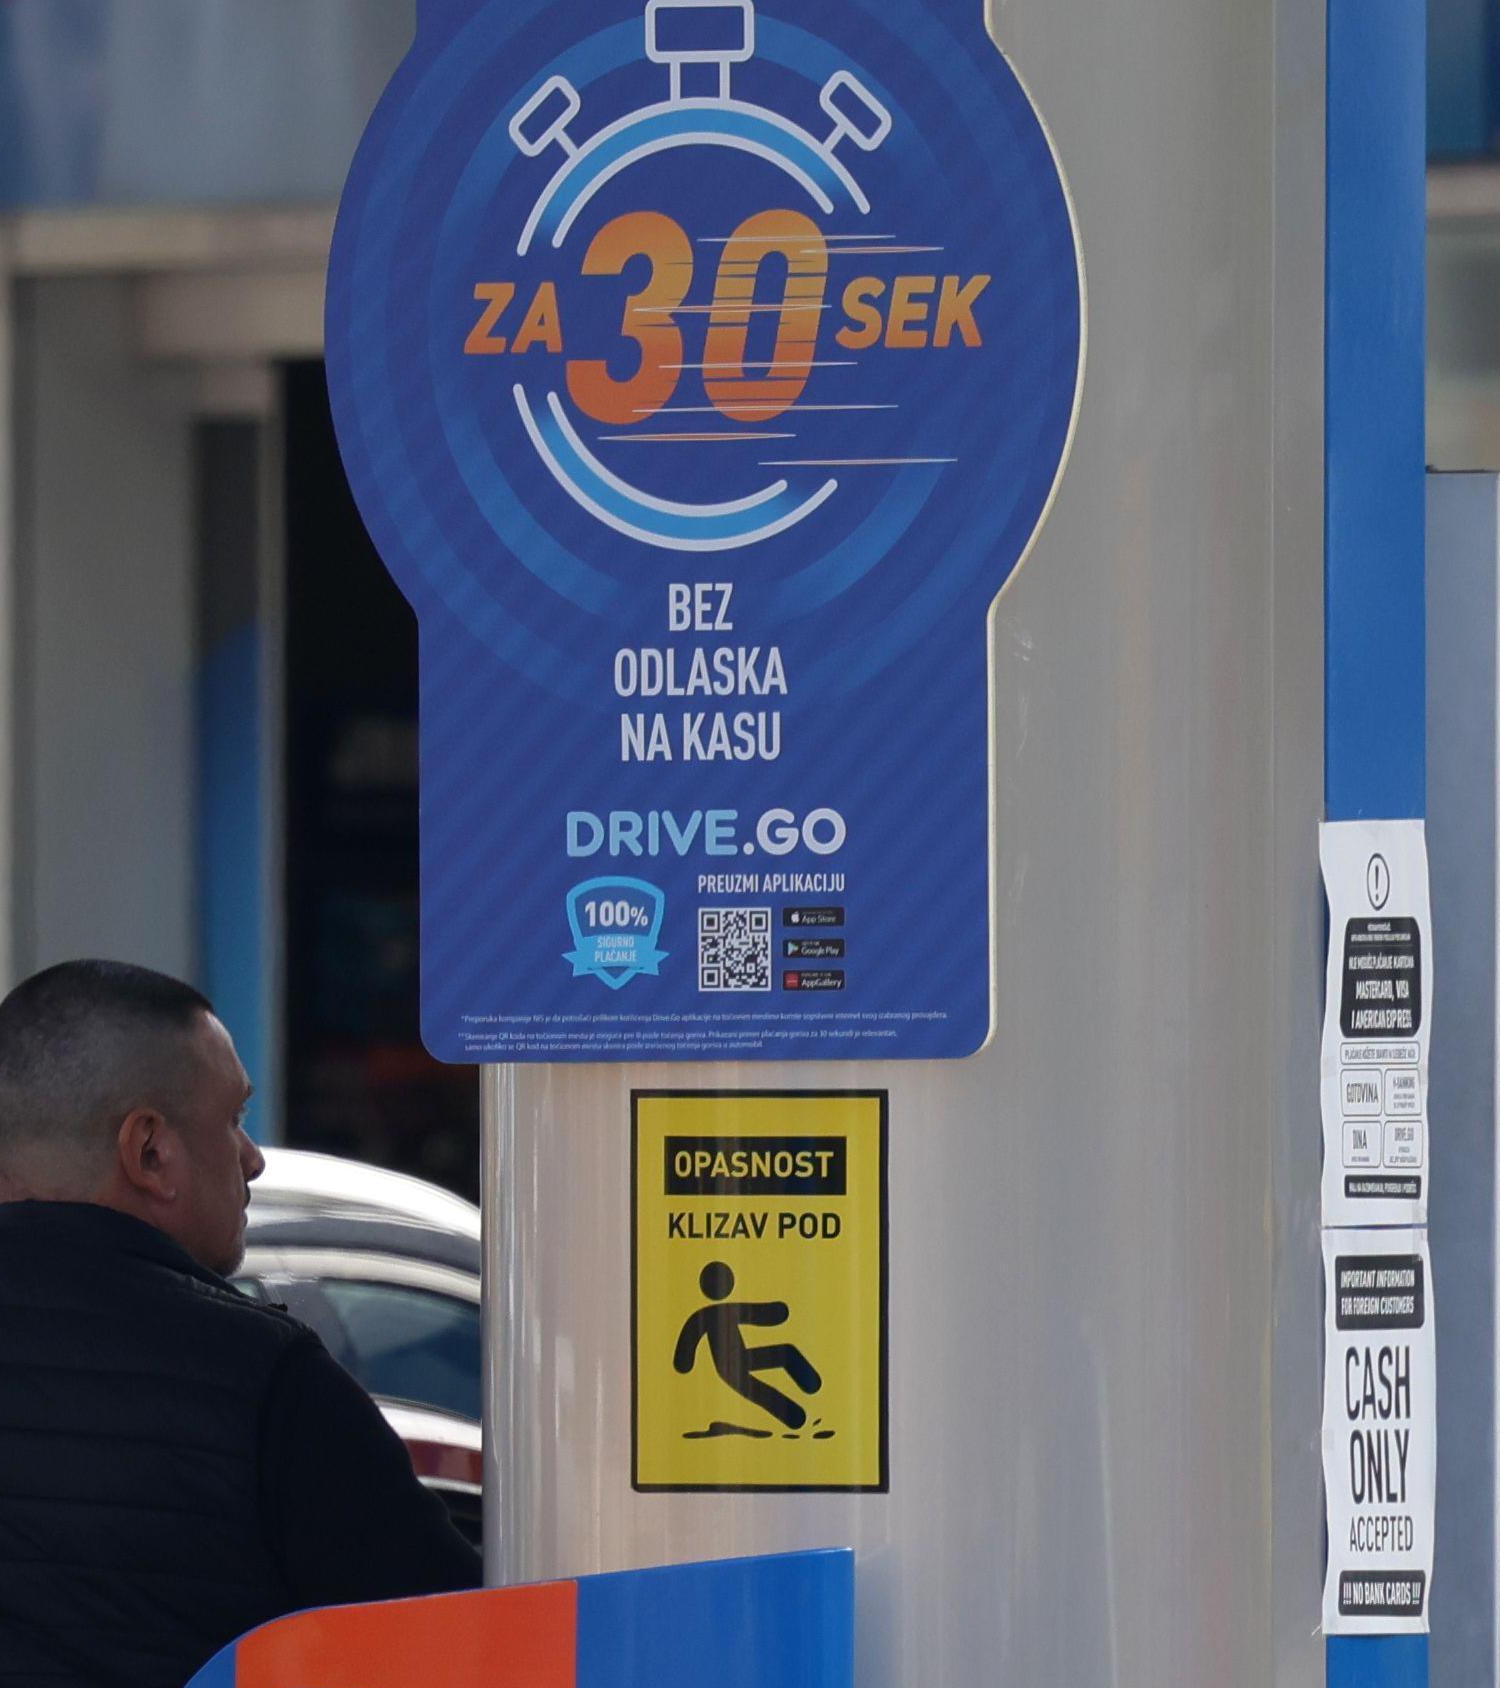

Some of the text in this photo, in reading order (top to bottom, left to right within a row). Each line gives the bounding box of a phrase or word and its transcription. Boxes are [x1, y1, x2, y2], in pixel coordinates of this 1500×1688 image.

[463, 208, 991, 426] ZA 30 SEK
[667, 582, 734, 632] BEZ
[613, 646, 788, 697] ODLASKA
[620, 711, 781, 762] NA KASU
[566, 807, 847, 858] DRIVE.GO
[697, 872, 845, 893] PREUZMI APLIKACIJU
[584, 900, 648, 928] 100%
[674, 1151, 834, 1177] OPASNOST
[668, 1212, 841, 1239] KLIZAV POD
[1345, 1345, 1411, 1421] CASH
[1350, 1429, 1410, 1504] ONLY
[1350, 1516, 1413, 1552] ACCEPTED
